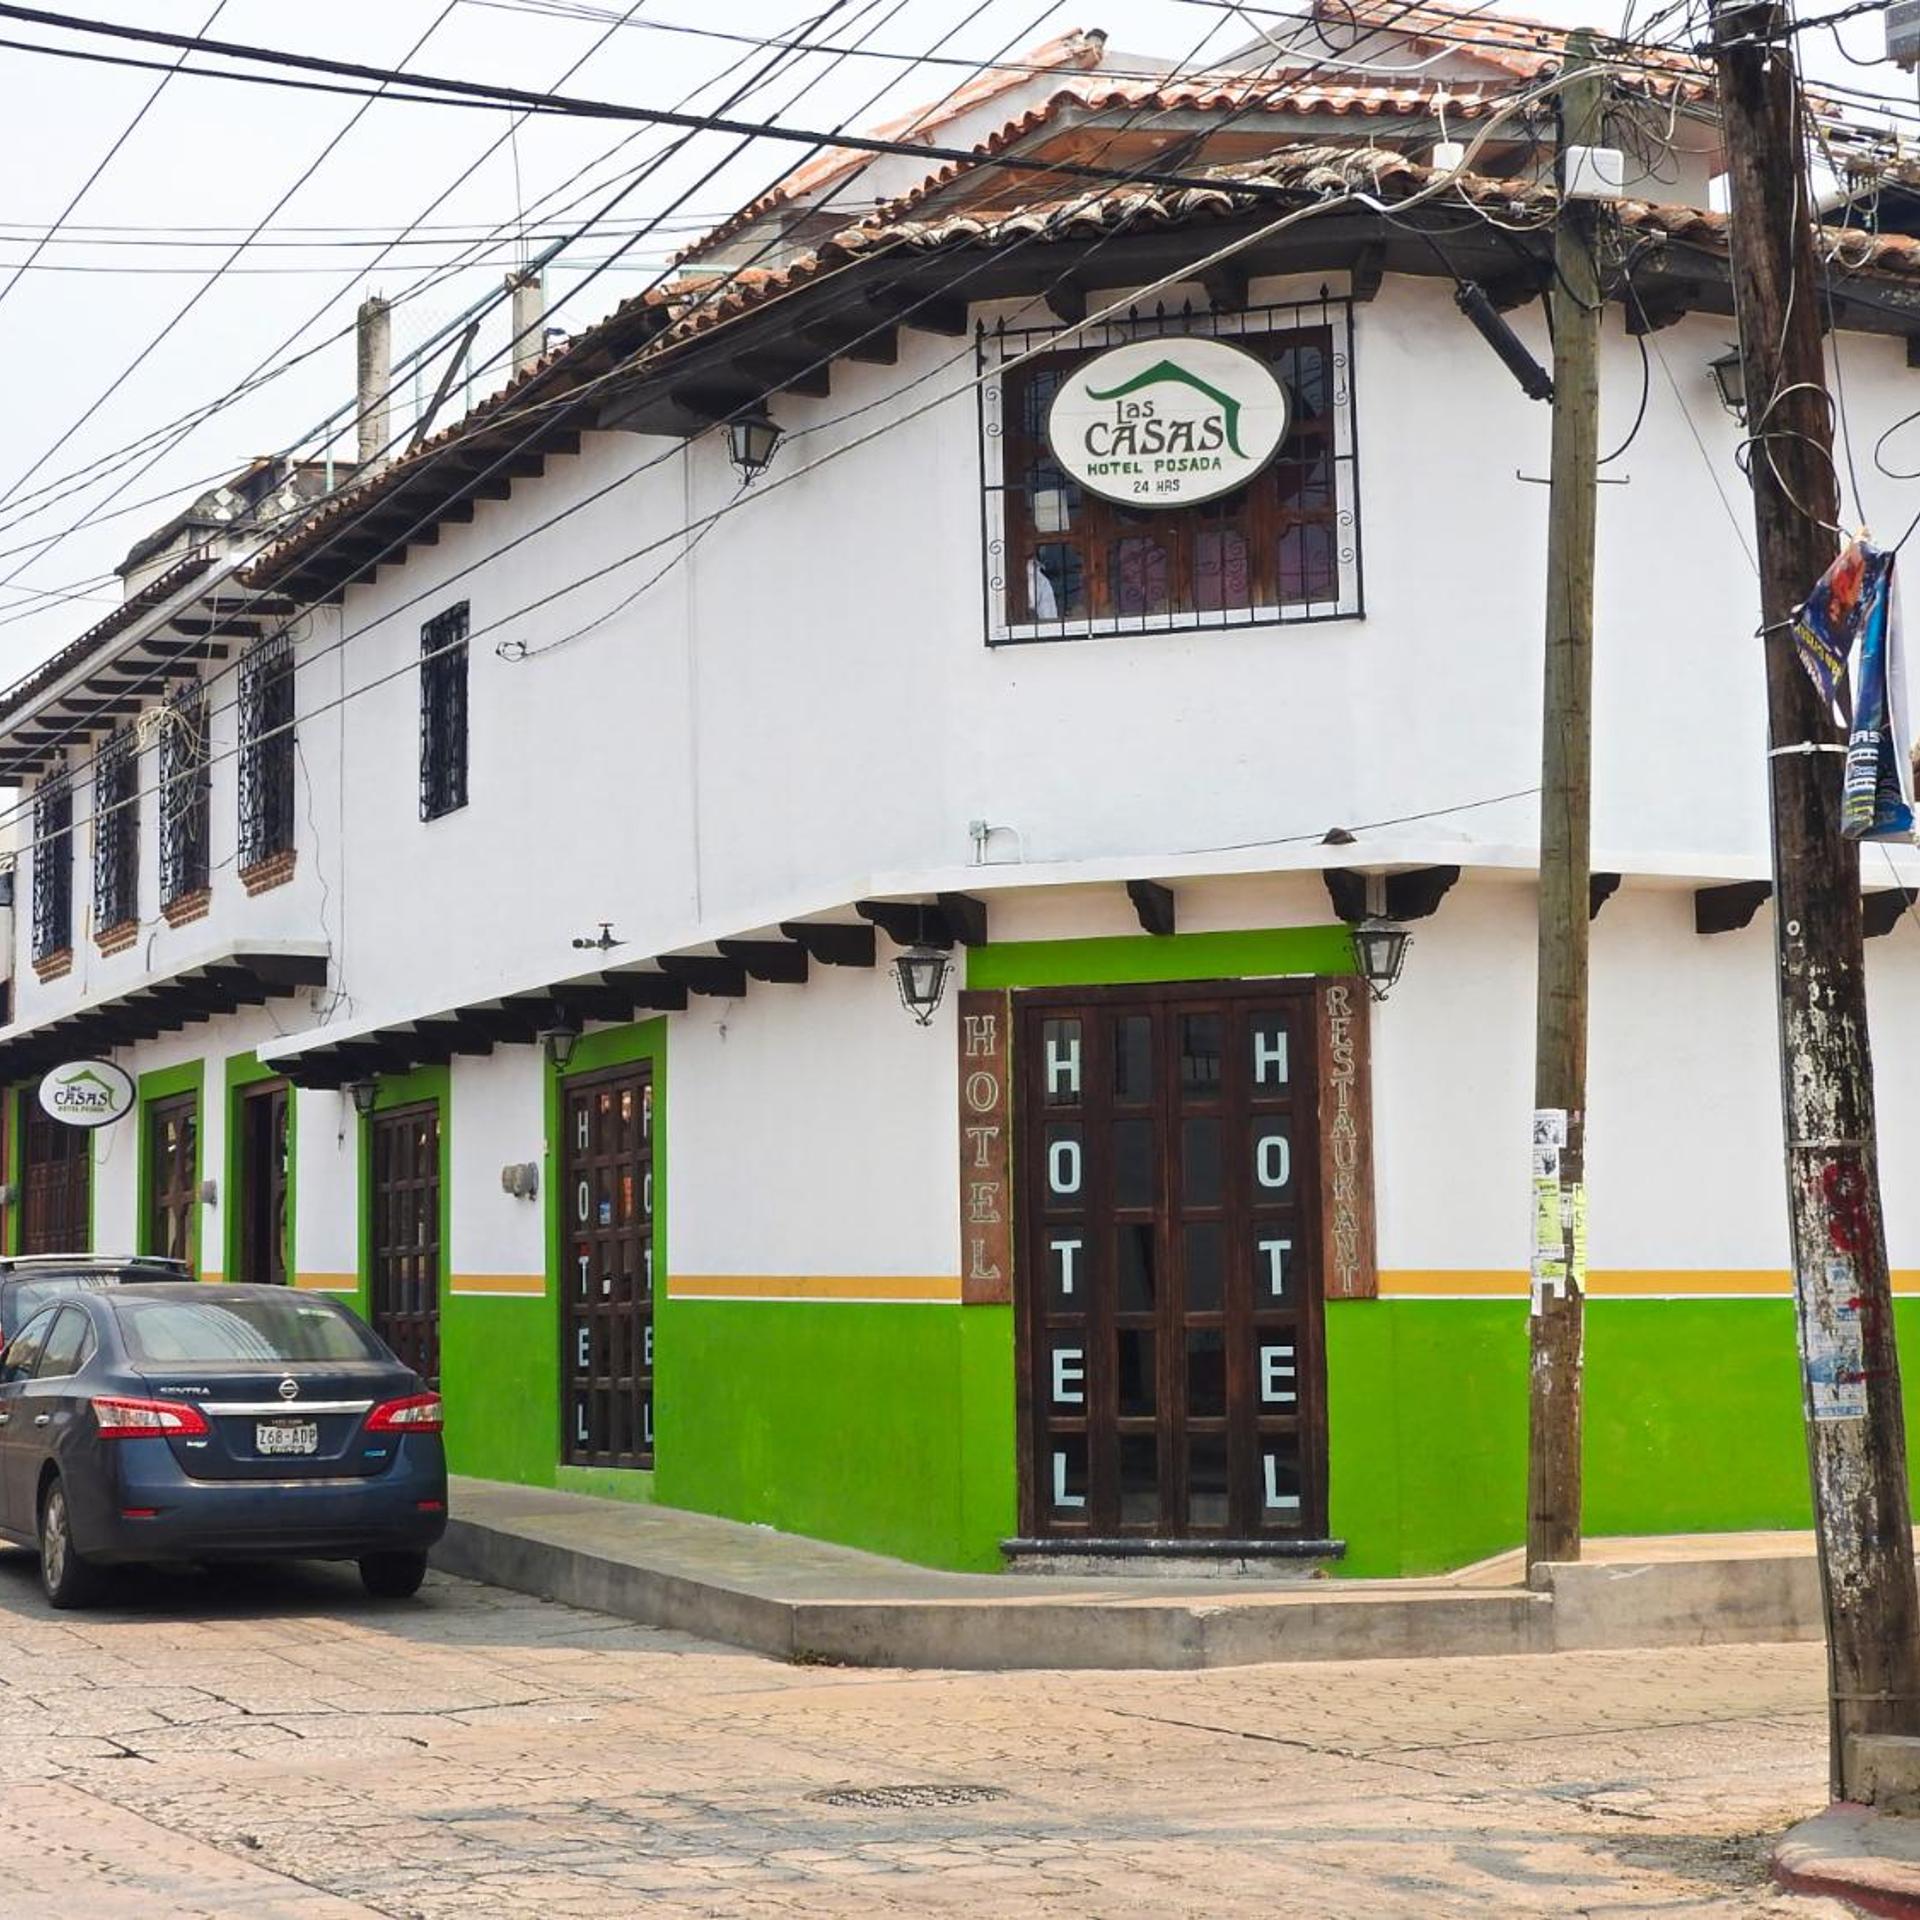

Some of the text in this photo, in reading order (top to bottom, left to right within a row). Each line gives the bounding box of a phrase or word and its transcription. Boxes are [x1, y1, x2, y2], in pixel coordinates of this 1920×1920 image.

[1084, 415, 1224, 457] CASAS
[1087, 456, 1222, 476] HOTEL POSADA
[1116, 400, 1154, 425] Las
[1133, 479, 1180, 493] 24 HRS
[54, 1091, 108, 1106] CASAS
[964, 1014, 1001, 1280] HOTEL
[1326, 985, 1361, 1293] RESTAURANT
[577, 1110, 590, 1440] HOTEL
[1047, 1039, 1086, 1508] HOTEL
[1254, 1031, 1301, 1508] HOTEL
